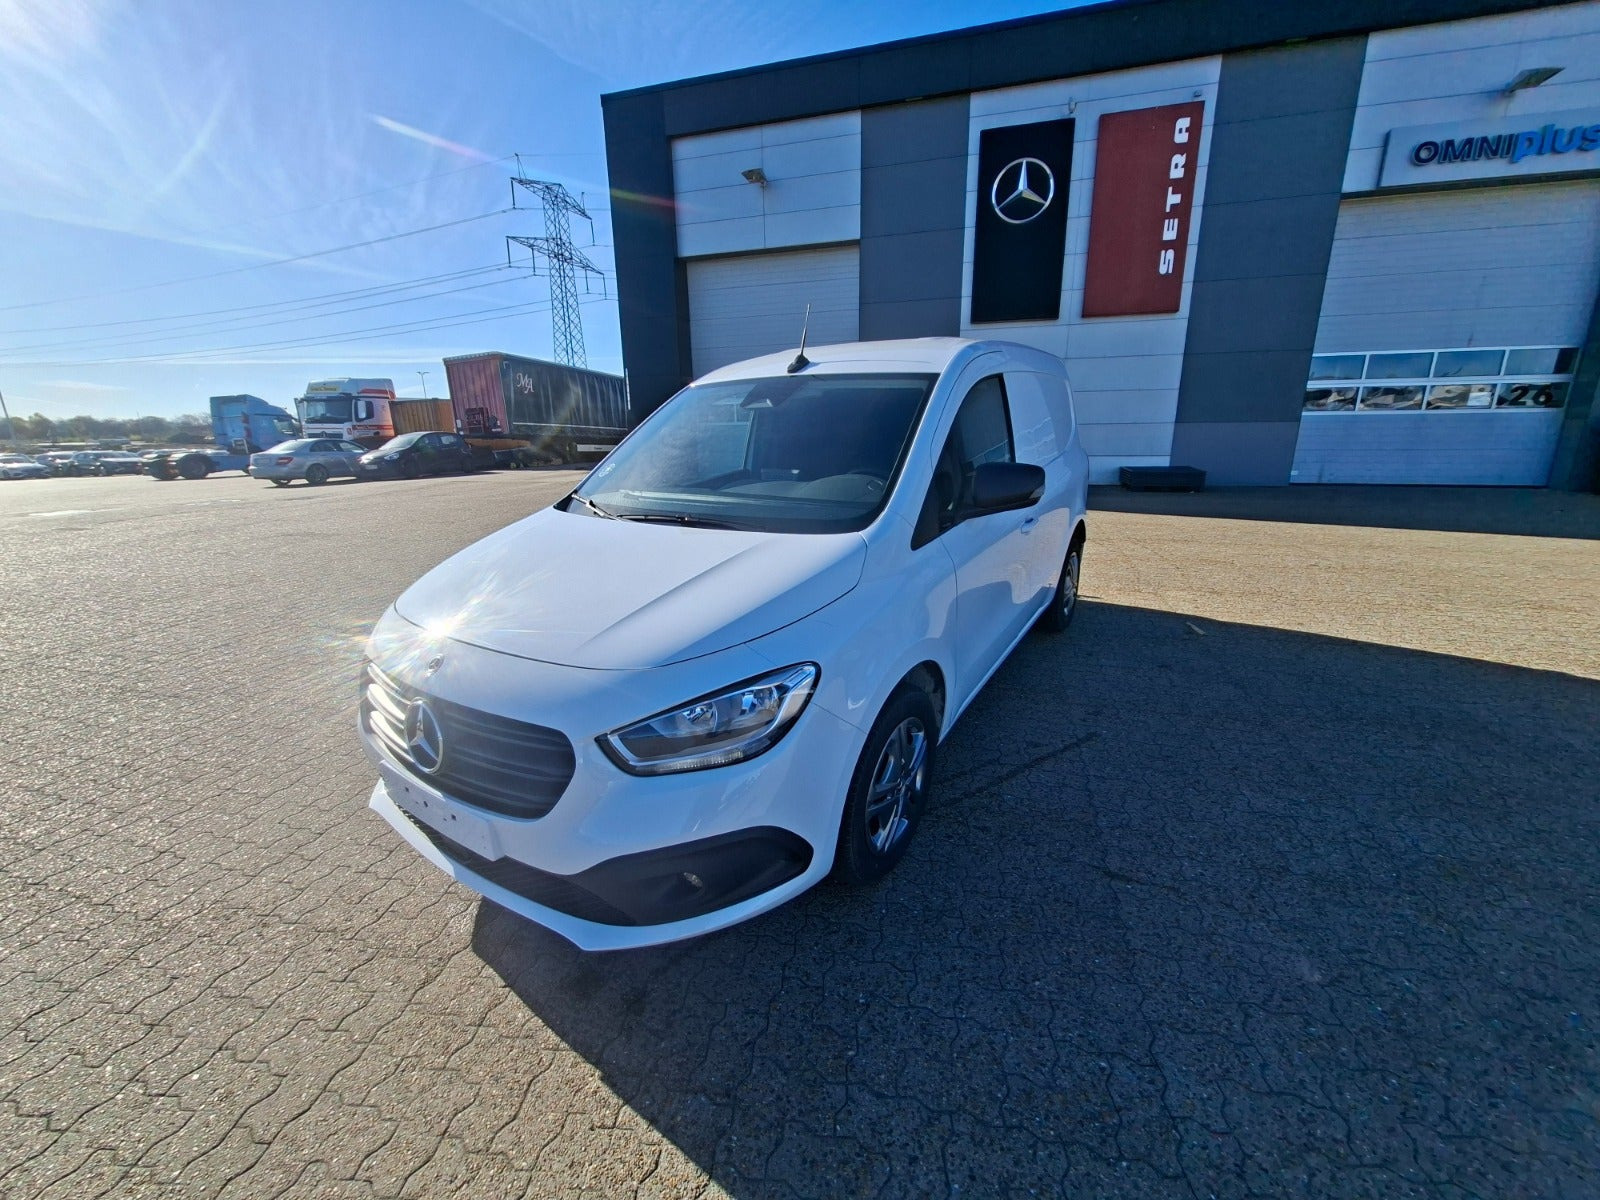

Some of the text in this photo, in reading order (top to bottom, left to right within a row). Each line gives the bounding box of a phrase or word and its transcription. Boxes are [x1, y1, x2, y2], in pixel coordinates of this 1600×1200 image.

[1412, 123, 1600, 166] OMNIplus
[1158, 116, 1191, 275] SETRA
[1508, 384, 1553, 406] 26
